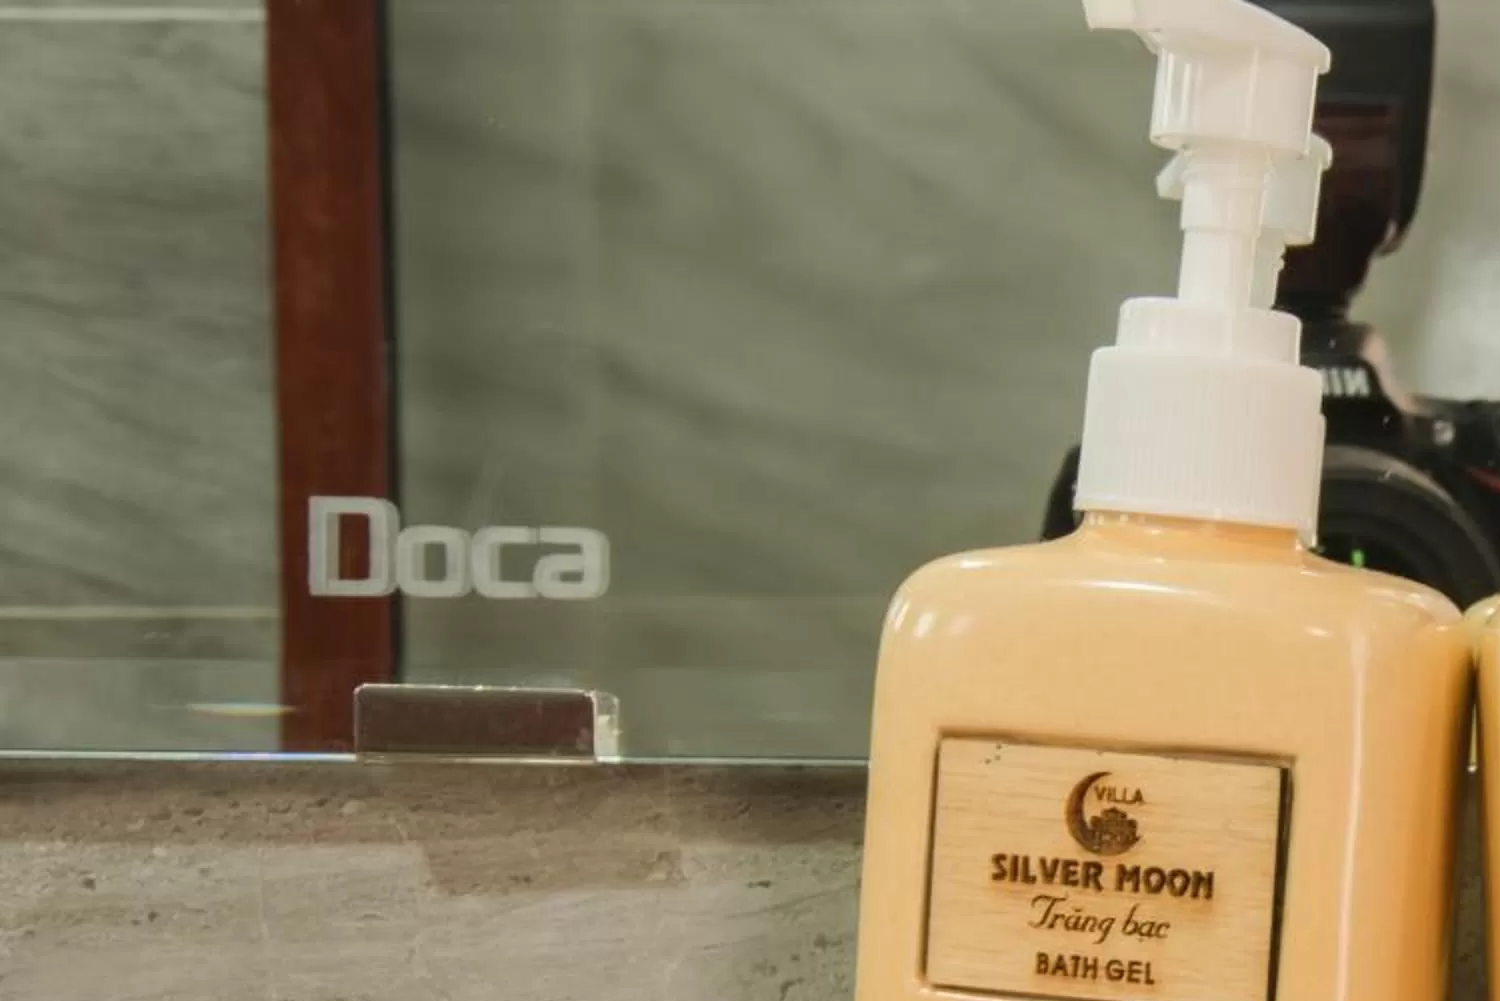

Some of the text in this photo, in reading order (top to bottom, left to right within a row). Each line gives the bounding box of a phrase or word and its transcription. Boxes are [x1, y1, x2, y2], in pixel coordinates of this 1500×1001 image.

[308, 495, 610, 598] Doca
[1093, 785, 1145, 805] VILLA
[990, 853, 1214, 900] SILVER MOON
[1027, 895, 1170, 945] Trăng bạc
[1035, 951, 1156, 986] BATH GEL
